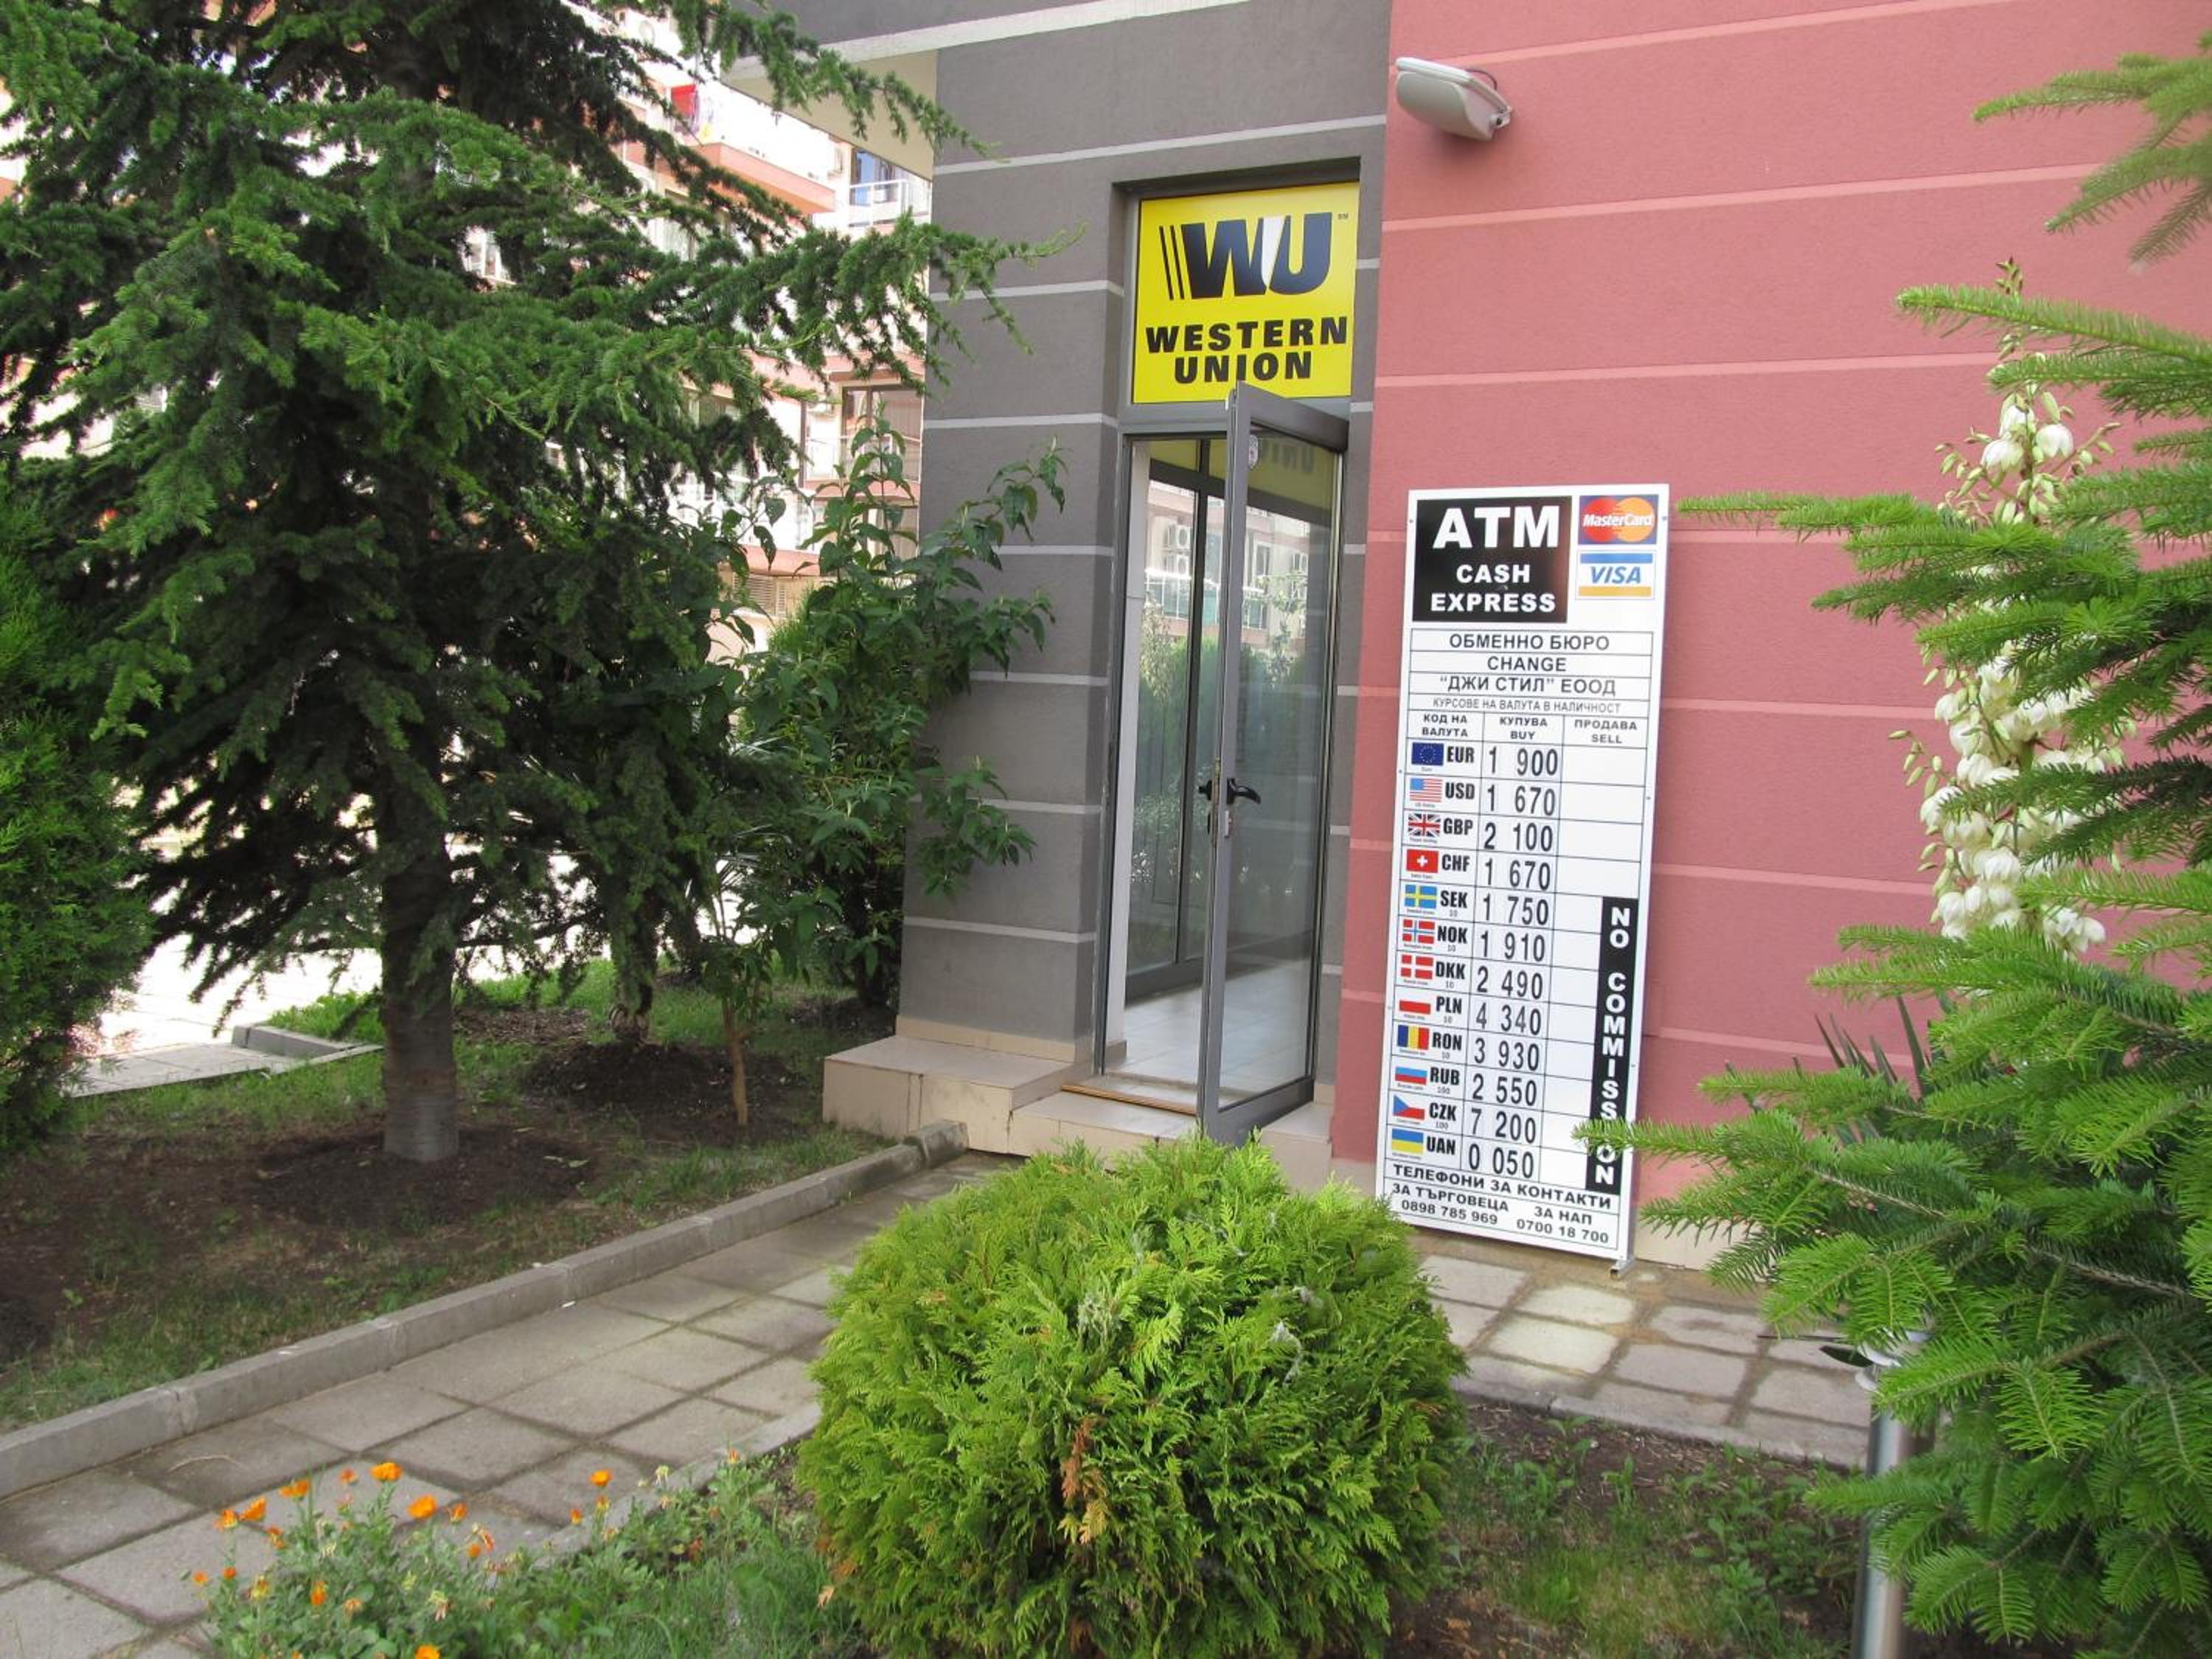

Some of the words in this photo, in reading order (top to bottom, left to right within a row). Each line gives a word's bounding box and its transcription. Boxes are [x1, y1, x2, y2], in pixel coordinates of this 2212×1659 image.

[1181, 212, 1332, 299] WU
[1146, 316, 1347, 353] WESTERN
[1175, 352, 1311, 383] UNION
[1433, 506, 1560, 549] ATM
[1583, 513, 1653, 527] MasterCard
[1456, 564, 1531, 583] CASH
[1590, 566, 1641, 584] VISA
[1431, 594, 1556, 613] EXPRESS
[1450, 633, 1543, 650] ОБМЕННО
[1550, 635, 1610, 650] БЮРО
[1487, 656, 1566, 672] CHANGE
[1561, 679, 1616, 697] ЕООД
[1424, 714, 1448, 725] КОД
[1452, 714, 1467, 724] НА
[1433, 698, 1479, 709] КУРСОВЕ
[1483, 699, 1497, 709] НА
[1500, 700, 1540, 711] ВАЛУТА
[1554, 702, 1621, 713] НАЛИЧНОСТ
[1422, 727, 1468, 737] ВАЛУТА
[1499, 717, 1547, 728] КУПУВА
[1511, 730, 1535, 740] BUY
[1574, 719, 1637, 731] ПРОДАВА
[1592, 734, 1622, 744] SELL
[1447, 747, 1474, 763] EUR
[1489, 746, 1497, 773] 1
[1517, 748, 1558, 775] 900
[1445, 782, 1475, 799] USD
[1488, 785, 1495, 812] 1
[1514, 786, 1556, 816] 670
[1444, 818, 1473, 835] GBP
[1484, 823, 1496, 850] 2
[1513, 824, 1553, 852] 100
[1441, 855, 1470, 872] CHF
[1486, 858, 1493, 886] 1
[1510, 860, 1550, 891] 670
[1440, 891, 1467, 908] SEK
[1484, 894, 1491, 921] 1
[1508, 897, 1548, 925] 750
[1610, 907, 1630, 948] NO
[1438, 926, 1467, 943] NOK
[1481, 931, 1489, 958] 1
[1505, 933, 1545, 961] 910
[1436, 961, 1465, 980] DKK
[1477, 966, 1489, 993] 2
[1502, 970, 1543, 999] 490
[1436, 996, 1461, 1015] PLN
[1476, 1002, 1486, 1029] 4
[1501, 1005, 1541, 1034] 340
[1432, 1032, 1461, 1050] RON
[1475, 1038, 1485, 1063] 3
[1498, 1040, 1539, 1071] 930
[1430, 1067, 1459, 1085] RUB
[1472, 1074, 1484, 1100] 2
[1496, 1077, 1537, 1106] 550
[1595, 972, 1627, 1184] COMMISSON
[1430, 1102, 1456, 1121] CZK
[1471, 1107, 1482, 1135] 7
[1495, 1111, 1536, 1144] 200
[1427, 1136, 1455, 1155] UAN
[1469, 1144, 1480, 1171] 0
[1492, 1147, 1534, 1178] 050
[1393, 1183, 1411, 1195] ЗА
[1416, 1187, 1509, 1212] ТЪРГОВЕЦА
[1394, 1164, 1484, 1189] ТЕЛЕФОНИ
[1491, 1180, 1511, 1193] ЗА
[1517, 1184, 1610, 1209] КОНТАКТИ
[1402, 1200, 1436, 1214] 0898
[1441, 1205, 1467, 1220] 785
[1472, 1210, 1498, 1225] 969
[1534, 1206, 1554, 1218] ЗА
[1559, 1210, 1592, 1225] НАП
[1517, 1219, 1552, 1234] 0700
[1559, 1225, 1576, 1238] 18
[1582, 1228, 1608, 1243] 700
